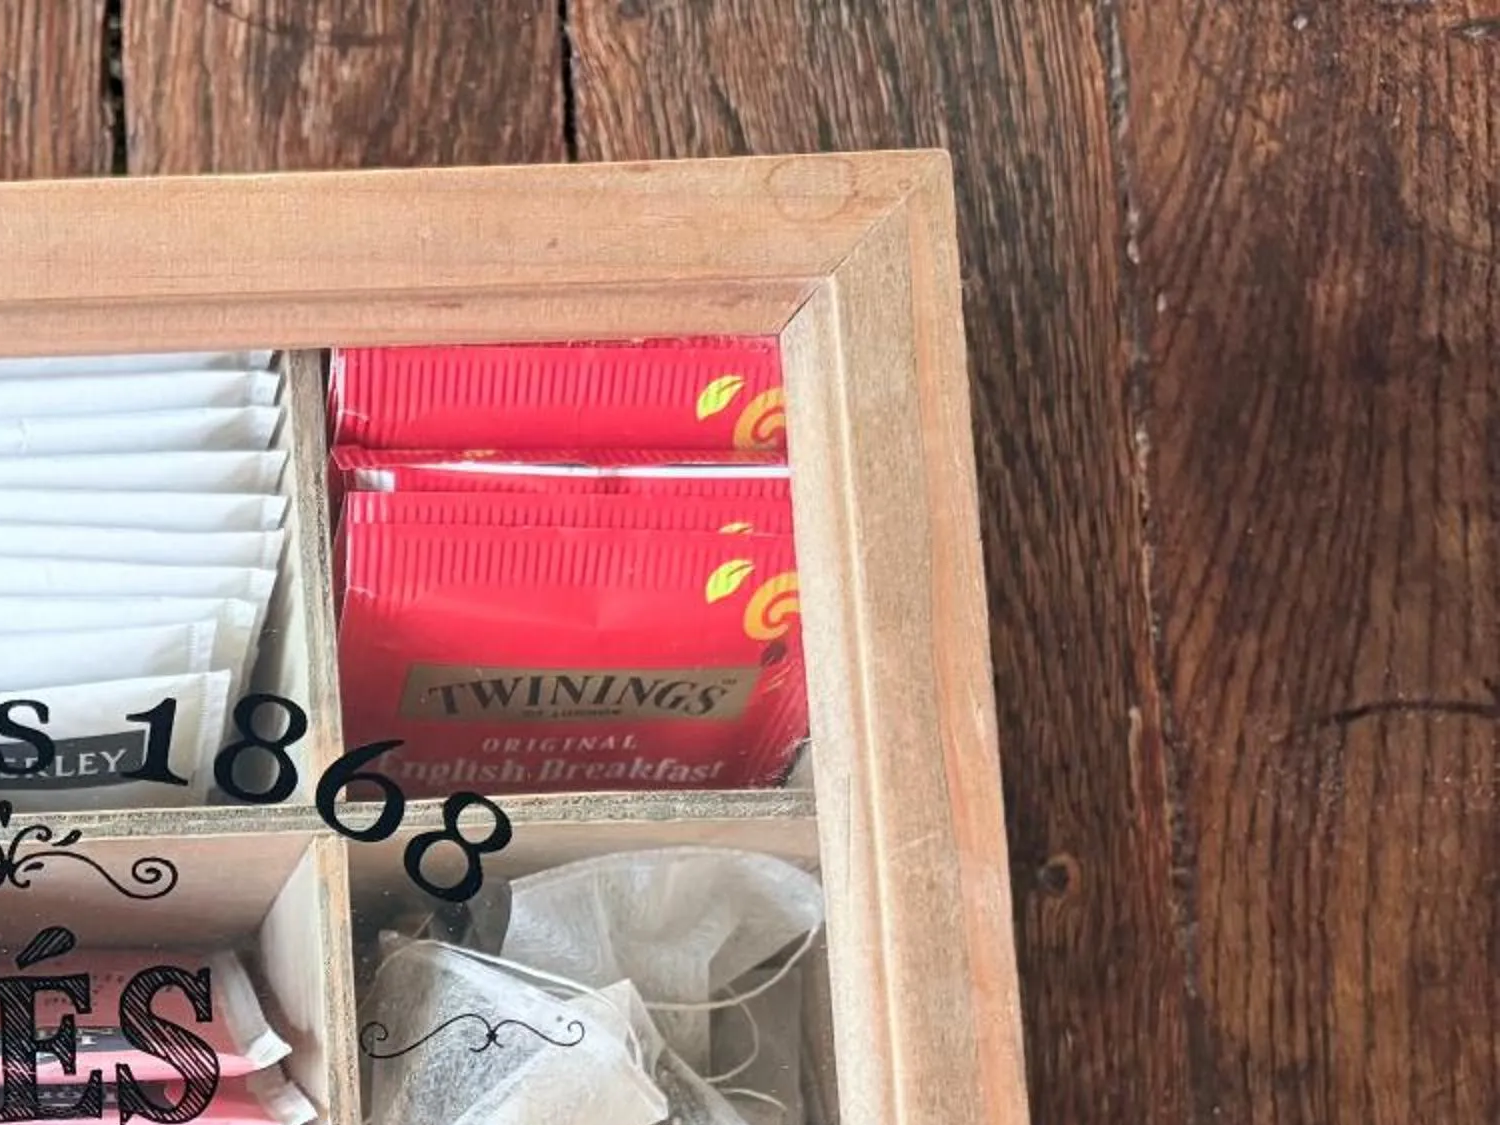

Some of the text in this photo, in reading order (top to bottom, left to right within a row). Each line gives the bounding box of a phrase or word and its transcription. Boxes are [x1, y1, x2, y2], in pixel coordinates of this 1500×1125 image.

[428, 675, 729, 716] TWININGS
[482, 734, 638, 753] ORIGINAL
[537, 753, 724, 784] Breakfast
[120, 693, 513, 902] 1868
